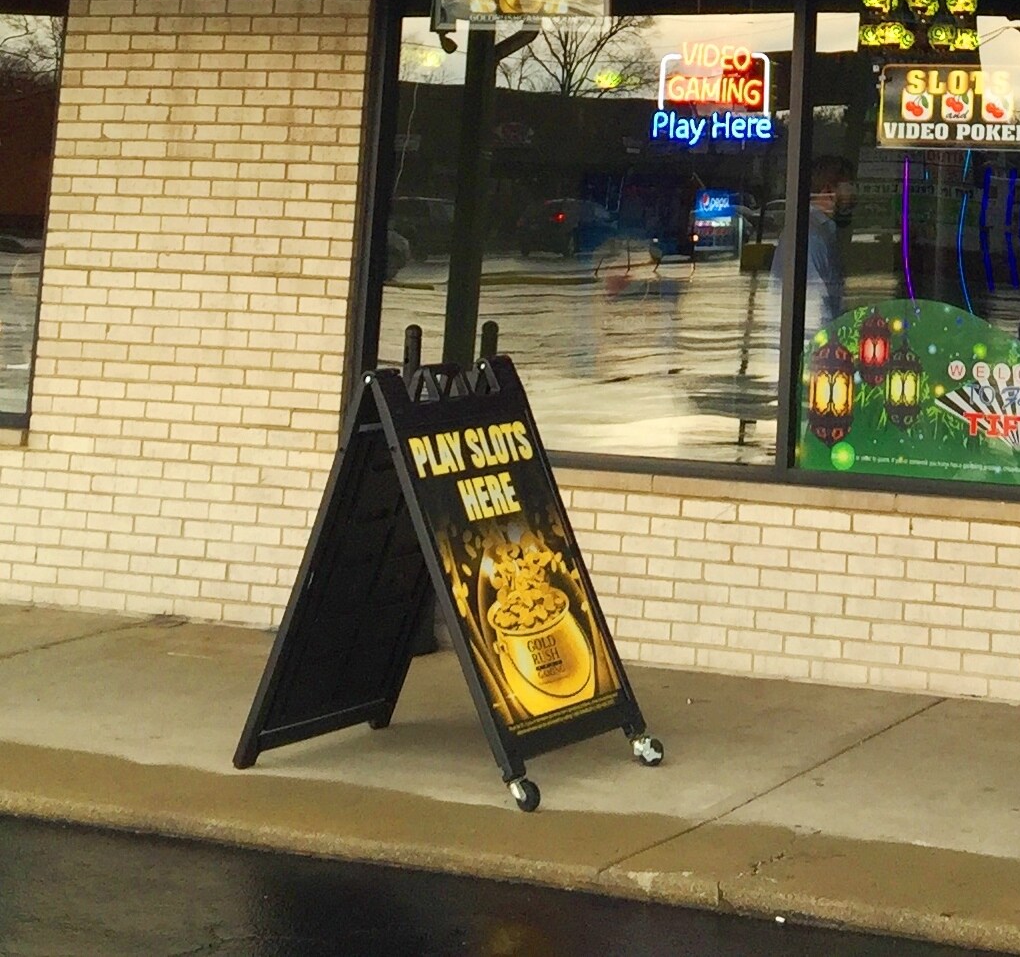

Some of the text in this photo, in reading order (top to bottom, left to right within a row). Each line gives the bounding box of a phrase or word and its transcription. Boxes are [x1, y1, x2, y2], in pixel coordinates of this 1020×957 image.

[682, 41, 752, 71] VIDEO
[667, 75, 763, 106] GAMING
[906, 69, 1011, 95] SLOTS
[945, 110, 970, 120] and
[652, 111, 772, 146] Play Here
[883, 122, 949, 141] VIDEO
[710, 194, 730, 212] pepsi
[969, 383, 996, 406] TO
[408, 420, 534, 479] PLAY SLOTS
[456, 471, 522, 522] HERE
[527, 634, 556, 653] GOLD
[531, 646, 560, 665] RUSH
